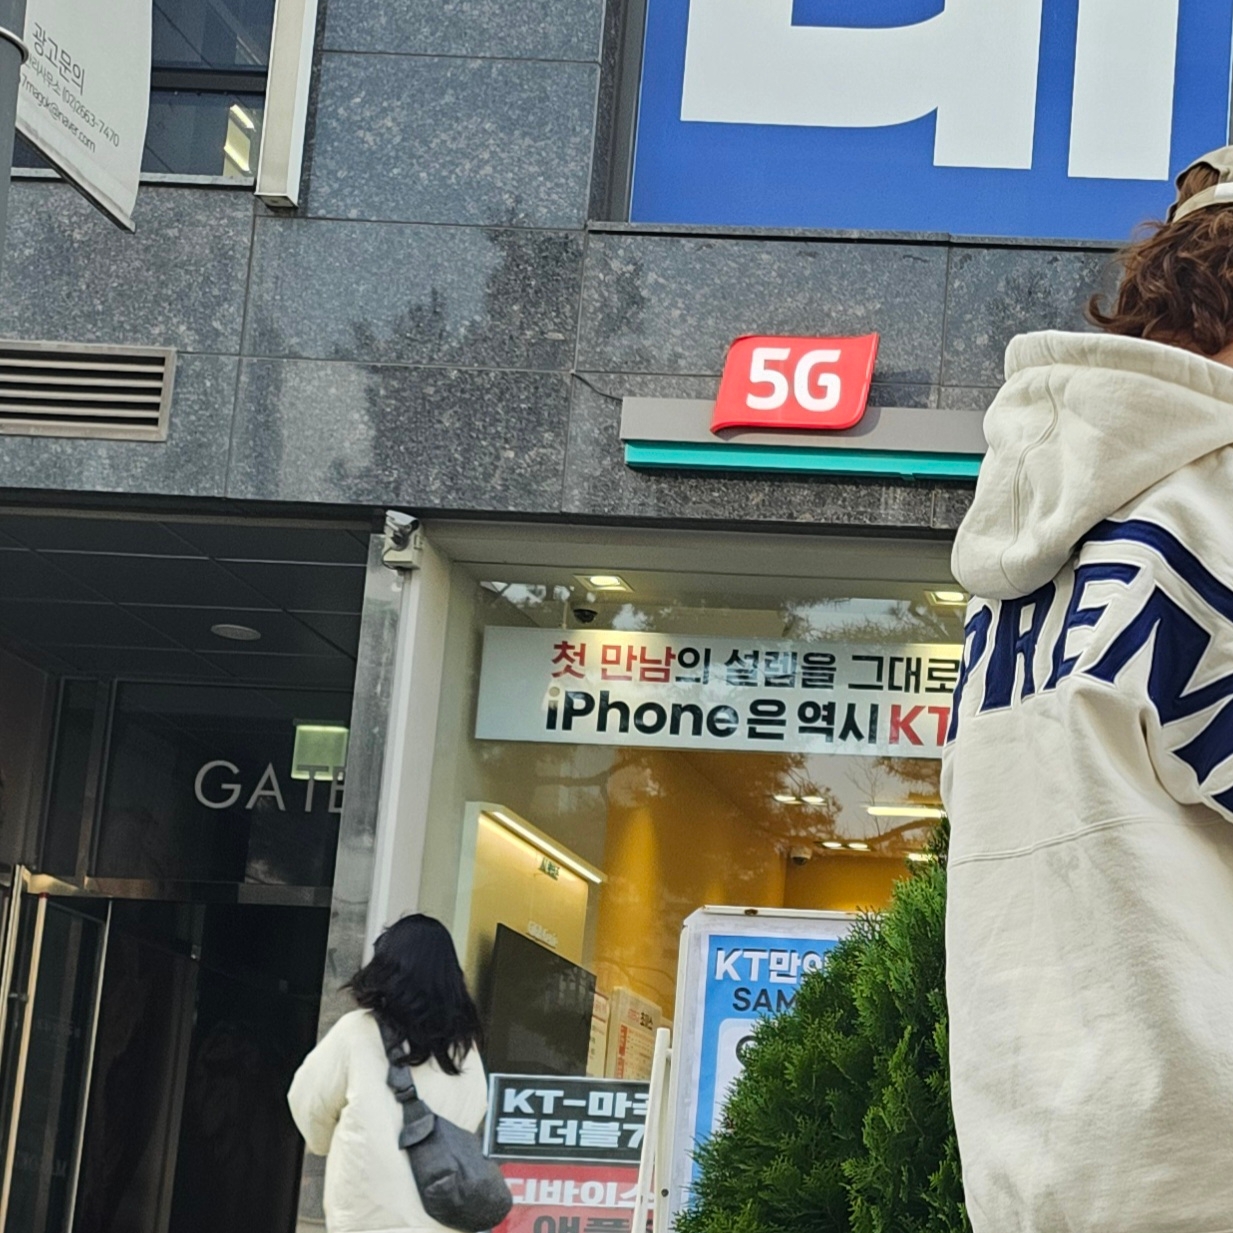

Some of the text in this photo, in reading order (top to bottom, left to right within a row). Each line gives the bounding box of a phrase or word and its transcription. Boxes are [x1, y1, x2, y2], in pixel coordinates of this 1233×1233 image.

[32, 22, 86, 96] 광고문의
[745, 346, 842, 412] 5G
[551, 640, 587, 680] 첫
[600, 643, 711, 686] 만남의
[847, 653, 961, 695] 그대로
